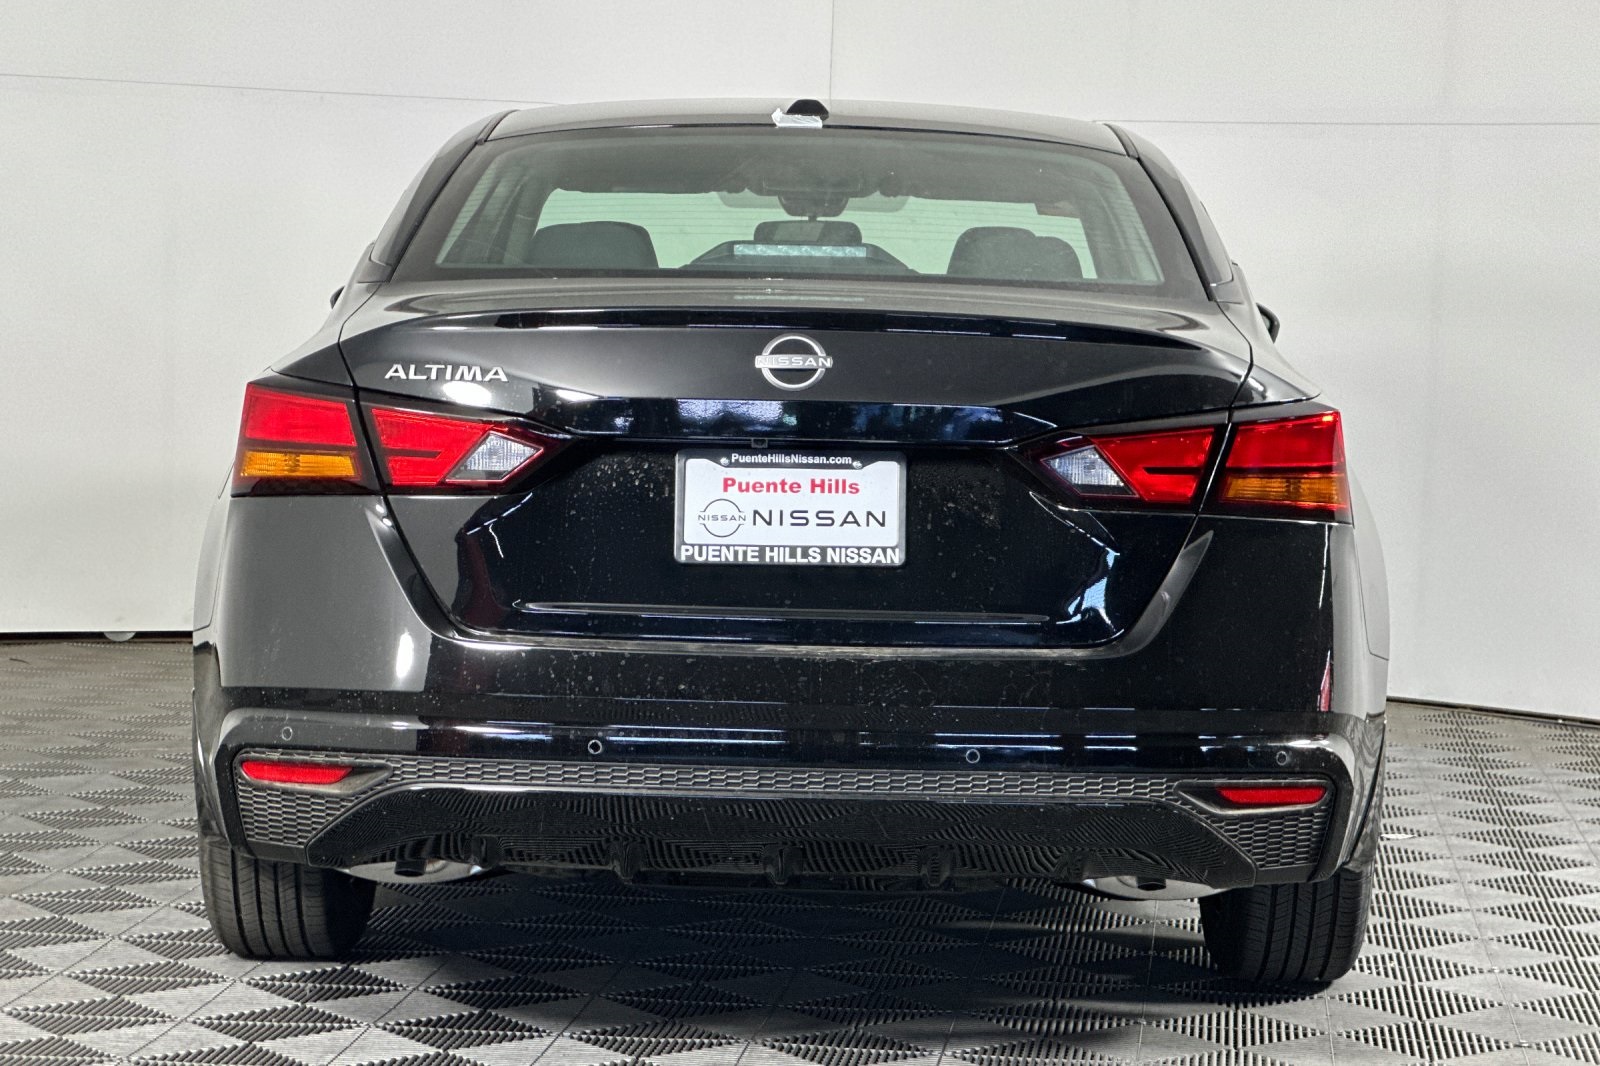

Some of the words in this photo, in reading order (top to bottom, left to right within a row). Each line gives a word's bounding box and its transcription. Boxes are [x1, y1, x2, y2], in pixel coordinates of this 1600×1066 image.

[757, 356, 832, 367] NISSAN
[384, 363, 508, 382] ALTIMA
[731, 453, 852, 464] PuenteHillsNissan.com
[722, 477, 802, 493] Puente
[810, 479, 860, 494] Hills
[698, 514, 746, 522] NISSAN
[753, 509, 886, 527] NISSAN
[680, 545, 759, 561] PUENTE
[765, 547, 821, 562] HILLS
[827, 548, 900, 564] NISSAN
